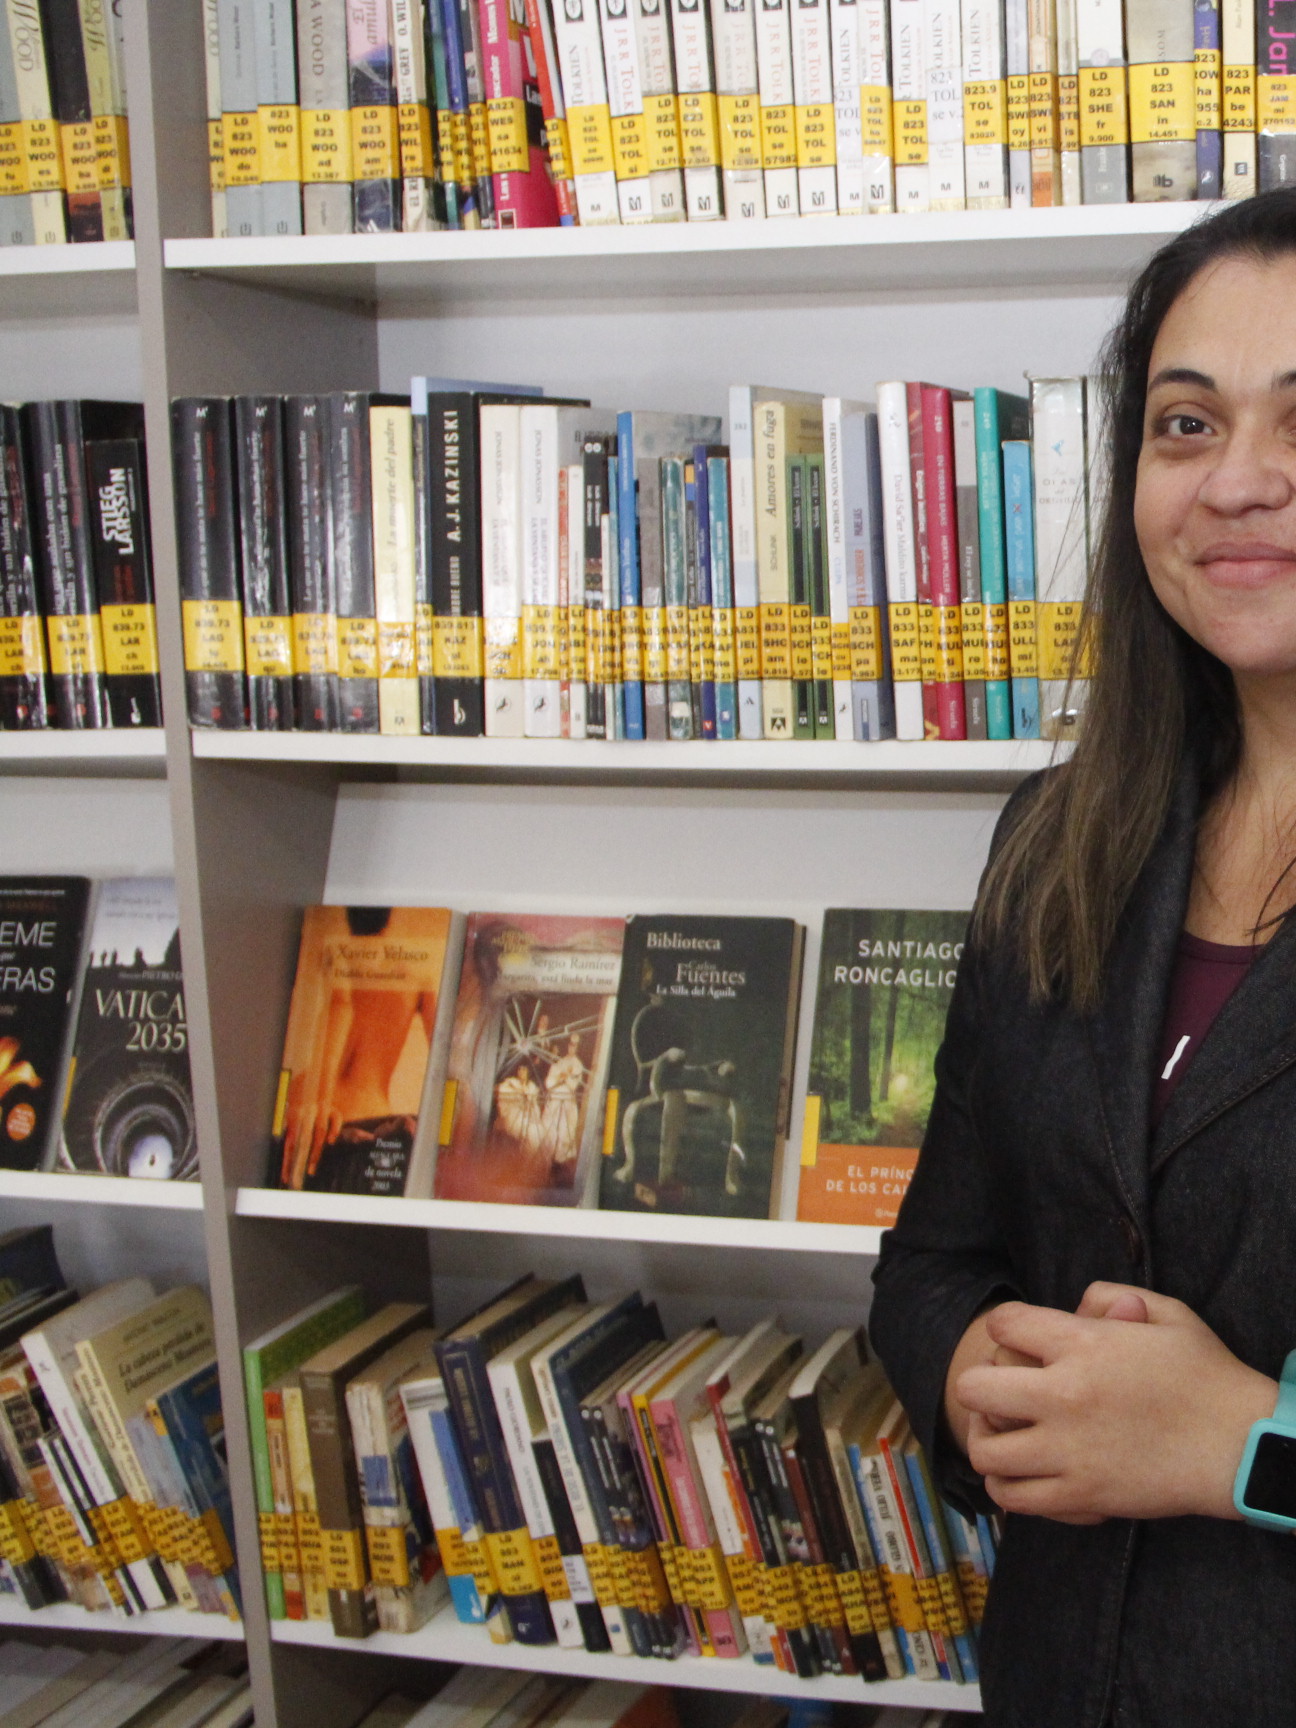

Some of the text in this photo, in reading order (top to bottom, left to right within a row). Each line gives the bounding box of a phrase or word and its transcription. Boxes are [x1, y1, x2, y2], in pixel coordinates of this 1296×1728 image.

[312, 16, 324, 76] WOOD
[969, 9, 982, 77] TOLKIEN
[399, 48, 410, 76] GREY
[899, 24, 912, 90] TOLKIEN
[569, 44, 584, 107] TOLKIEN
[1092, 72, 1108, 80] LD
[1154, 68, 1169, 77] LD
[965, 84, 997, 96] 823.9
[1225, 86, 1250, 95] PAR
[970, 102, 993, 111] TOL
[1088, 104, 1113, 113] SHE
[1150, 100, 1175, 109] SAN
[1231, 102, 1245, 111] be
[316, 114, 330, 122] LD
[621, 120, 635, 129] LD
[1097, 119, 1106, 129] fr
[314, 129, 333, 137] 823
[620, 135, 639, 144] 823
[312, 144, 338, 152] WOO
[620, 150, 643, 159] TOL
[384, 418, 397, 455] padre
[444, 411, 459, 504] KAZINSKI
[763, 410, 776, 518] Amores en fuga
[385, 458, 396, 478] del
[829, 423, 840, 543] FERDINAND VON SCHIRACH
[99, 483, 121, 542] STIEG
[107, 468, 134, 554] LARSSON
[770, 535, 778, 570] SCHLINK
[896, 608, 910, 616] LD
[893, 639, 916, 647] SAF
[0, 921, 57, 946] EME
[647, 932, 720, 950] Biblioteca
[336, 944, 428, 963] Xavier Velasco
[676, 962, 745, 988] Fuentes
[656, 984, 736, 999] La Silla del Águila
[96, 989, 184, 1020] VATICA
[126, 1021, 186, 1051] 2035
[847, 1165, 863, 1178] EL
[826, 1180, 844, 1192] DE
[850, 1181, 876, 1194] LOS
